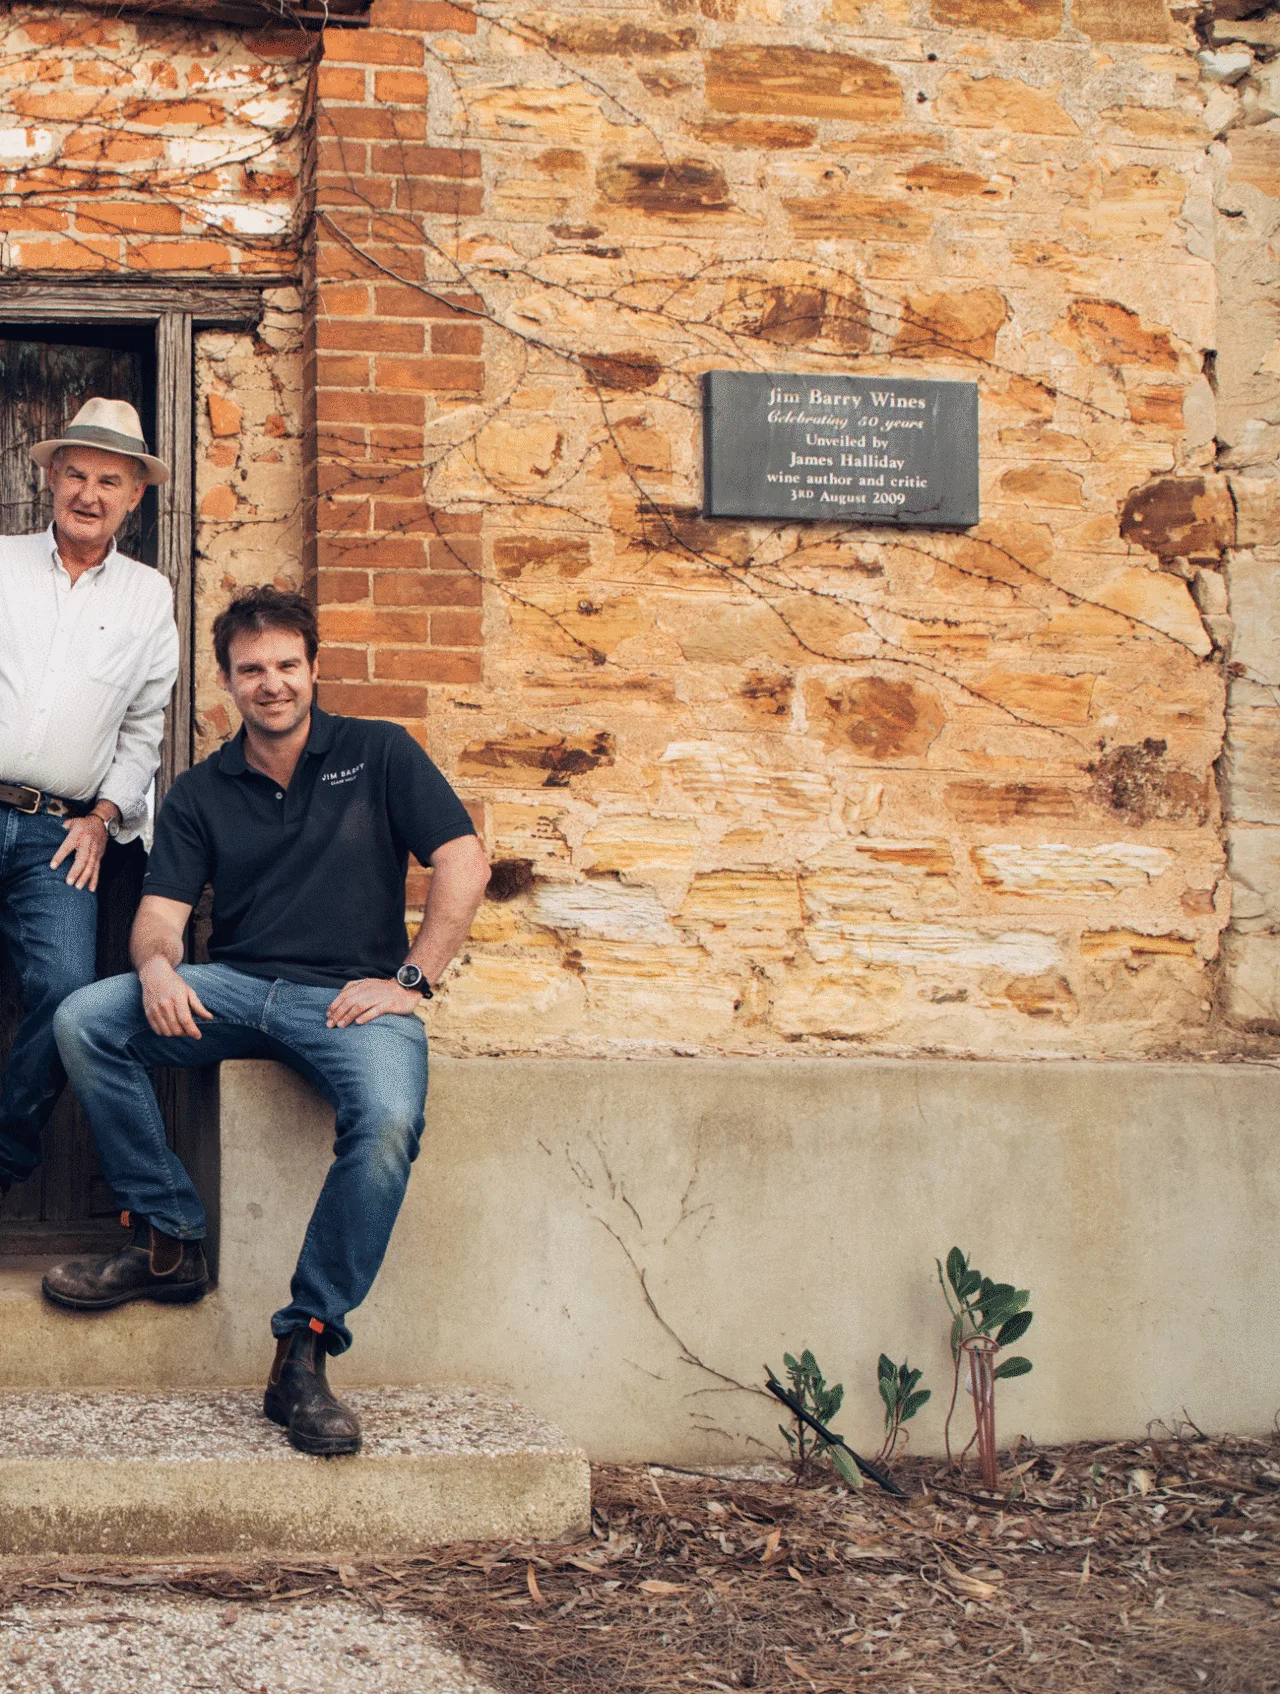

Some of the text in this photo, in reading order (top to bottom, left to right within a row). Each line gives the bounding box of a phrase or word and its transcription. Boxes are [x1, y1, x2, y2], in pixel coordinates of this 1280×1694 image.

[767, 388, 926, 409] Jim Barry Wines
[767, 410, 925, 432] Celebrating 50 years
[806, 434, 889, 450] Unveiled by
[789, 451, 905, 471] James Halliday
[767, 472, 928, 488] wine author and critic
[790, 490, 906, 505] 3RD August 2009
[321, 772, 338, 781] JIM
[341, 762, 365, 777] BARRY
